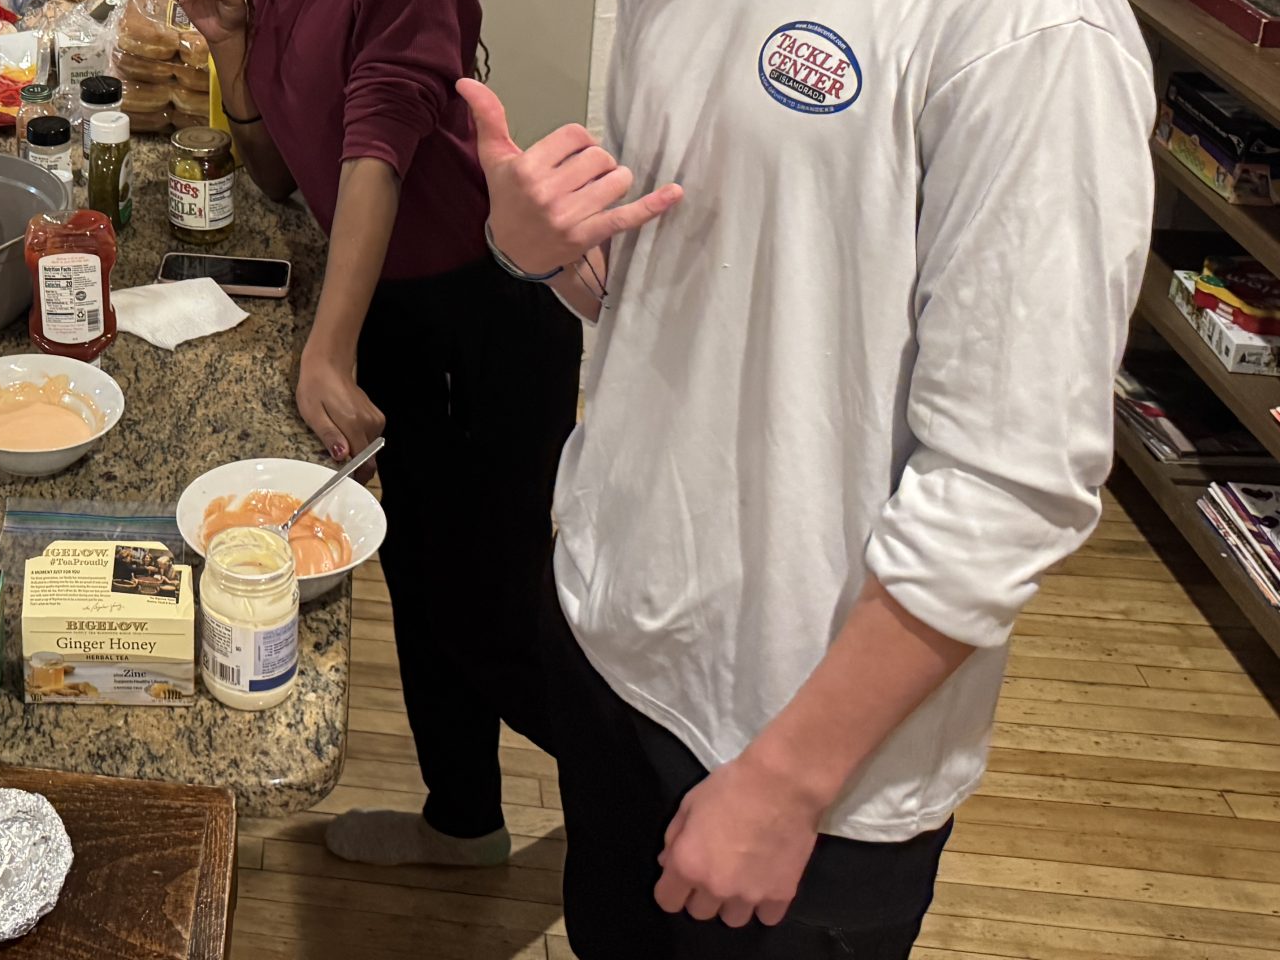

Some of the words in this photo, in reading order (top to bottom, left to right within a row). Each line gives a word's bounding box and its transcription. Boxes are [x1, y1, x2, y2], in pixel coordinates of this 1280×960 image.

[777, 33, 850, 78] TACKLE
[768, 50, 844, 99] CENTER
[770, 69, 779, 78] OF
[779, 73, 824, 102] ISLAMORADA
[44, 548, 108, 557] IGELOW
[50, 558, 108, 568] #TeaProudly
[66, 621, 146, 631] BIGELOW
[56, 637, 105, 652] Ginger
[110, 638, 157, 653] Honey
[123, 669, 146, 678] Zinc
